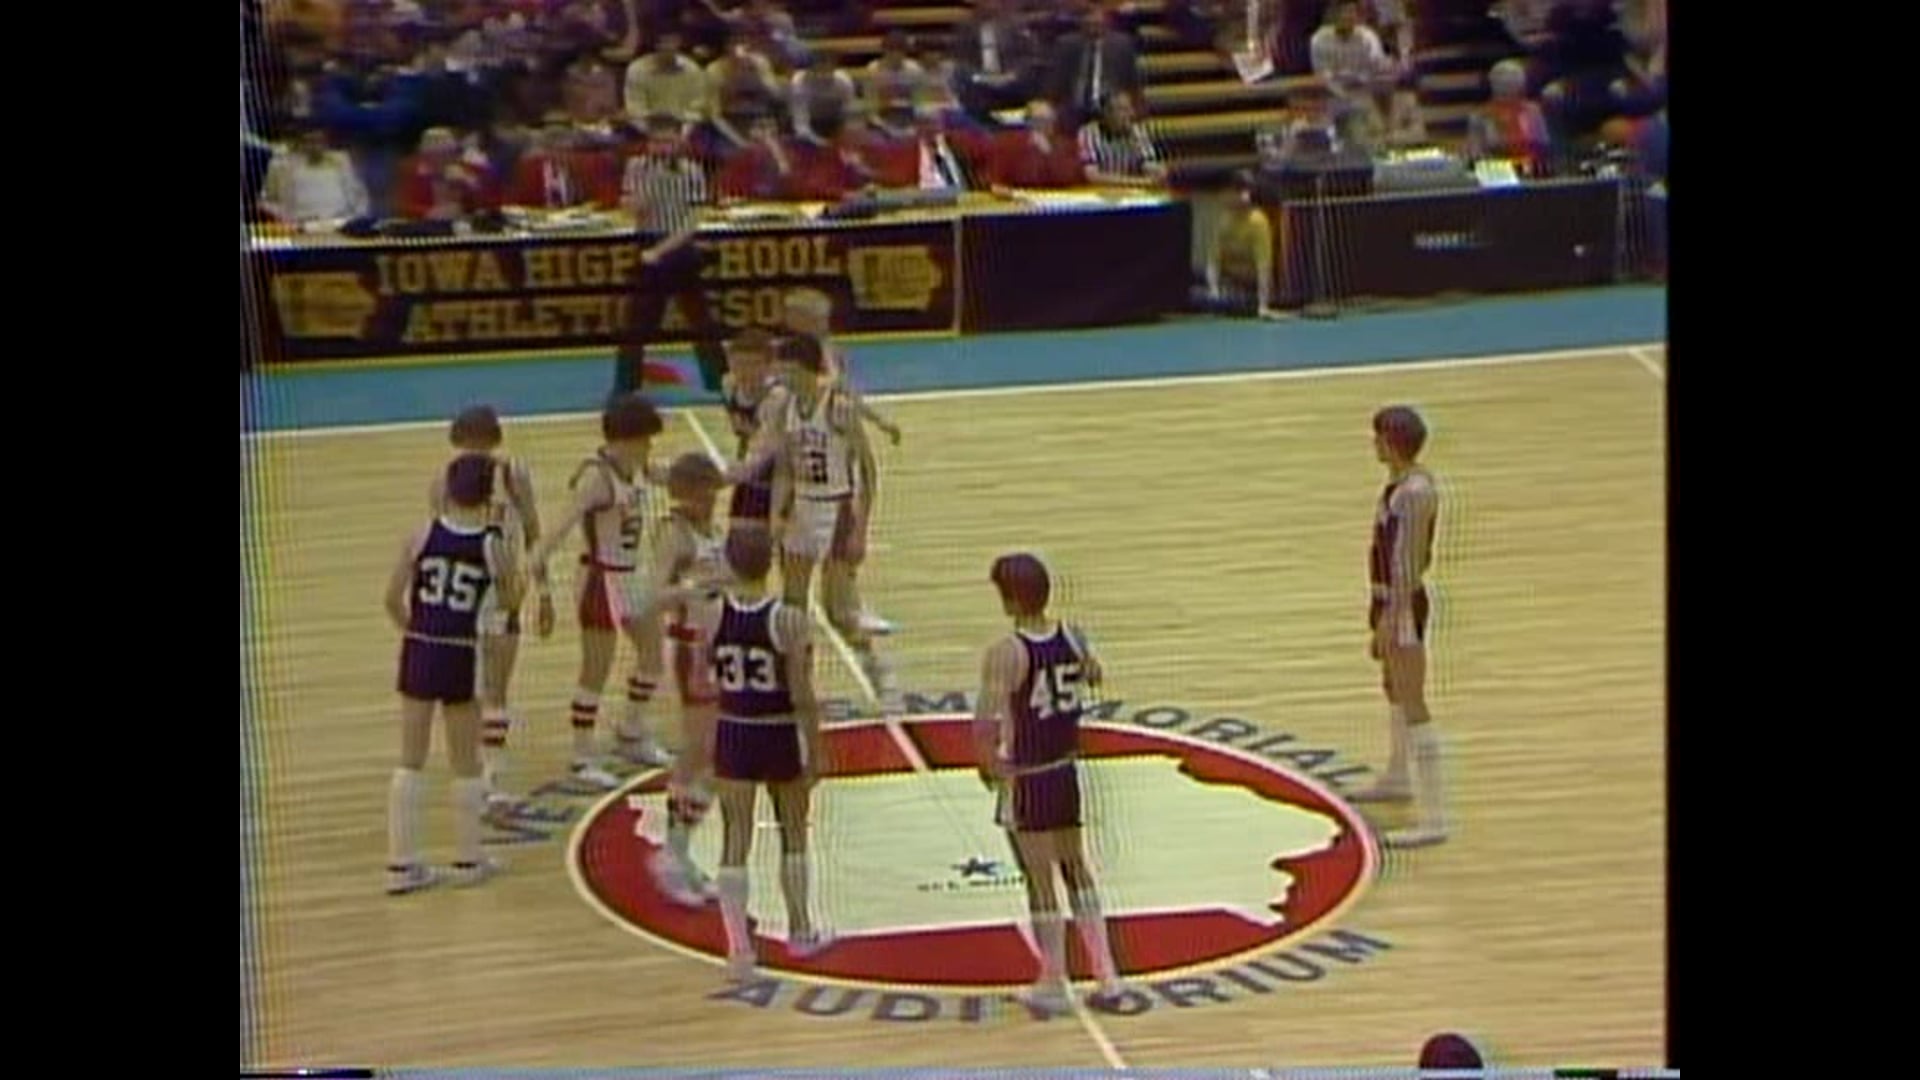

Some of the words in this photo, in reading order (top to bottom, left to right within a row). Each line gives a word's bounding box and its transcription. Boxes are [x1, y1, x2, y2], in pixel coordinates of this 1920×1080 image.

[377, 250, 508, 295] IOWA
[419, 556, 484, 612] 35
[716, 644, 776, 692] 33
[1030, 661, 1083, 719] 45
